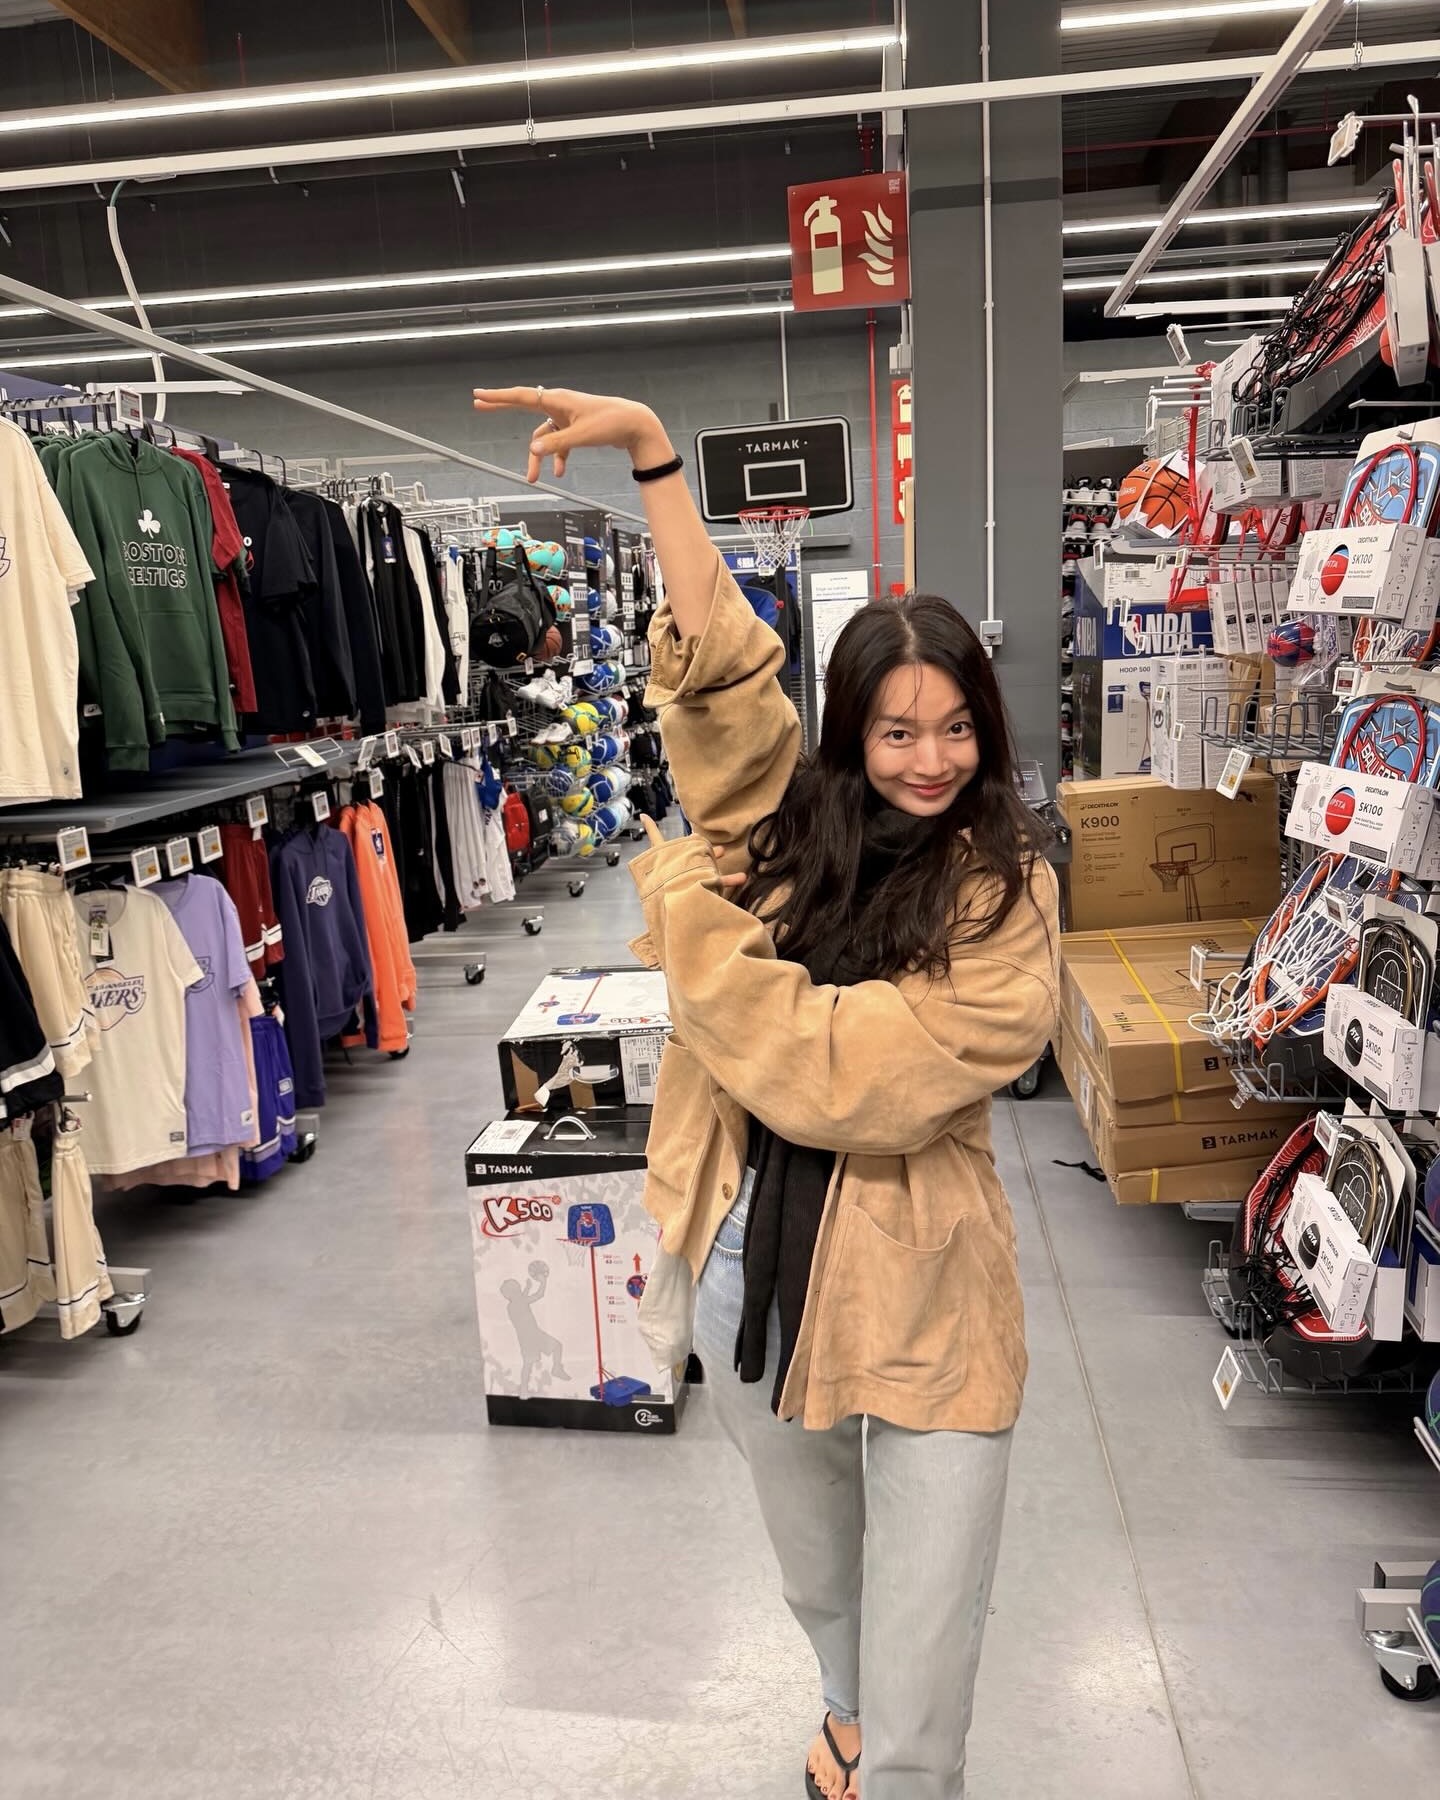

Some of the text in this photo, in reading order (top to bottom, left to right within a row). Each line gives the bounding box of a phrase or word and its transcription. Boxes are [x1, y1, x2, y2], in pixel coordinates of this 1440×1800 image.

[745, 439, 800, 454] TARMAK
[1351, 552, 1374, 565] SK100
[1081, 616, 1097, 657] NBA
[1145, 612, 1194, 655] NBA
[1120, 665, 1151, 674] HOOP 500
[1364, 785, 1390, 797] DECATHLON
[1087, 801, 1120, 809] DECATHLON
[1358, 801, 1384, 817] SK100
[1080, 815, 1121, 829] K900
[1220, 1128, 1279, 1146] TARMAK
[488, 1164, 533, 1174] TARMAK
[482, 1196, 553, 1232] K500
[640, 1412, 647, 1422] 2
